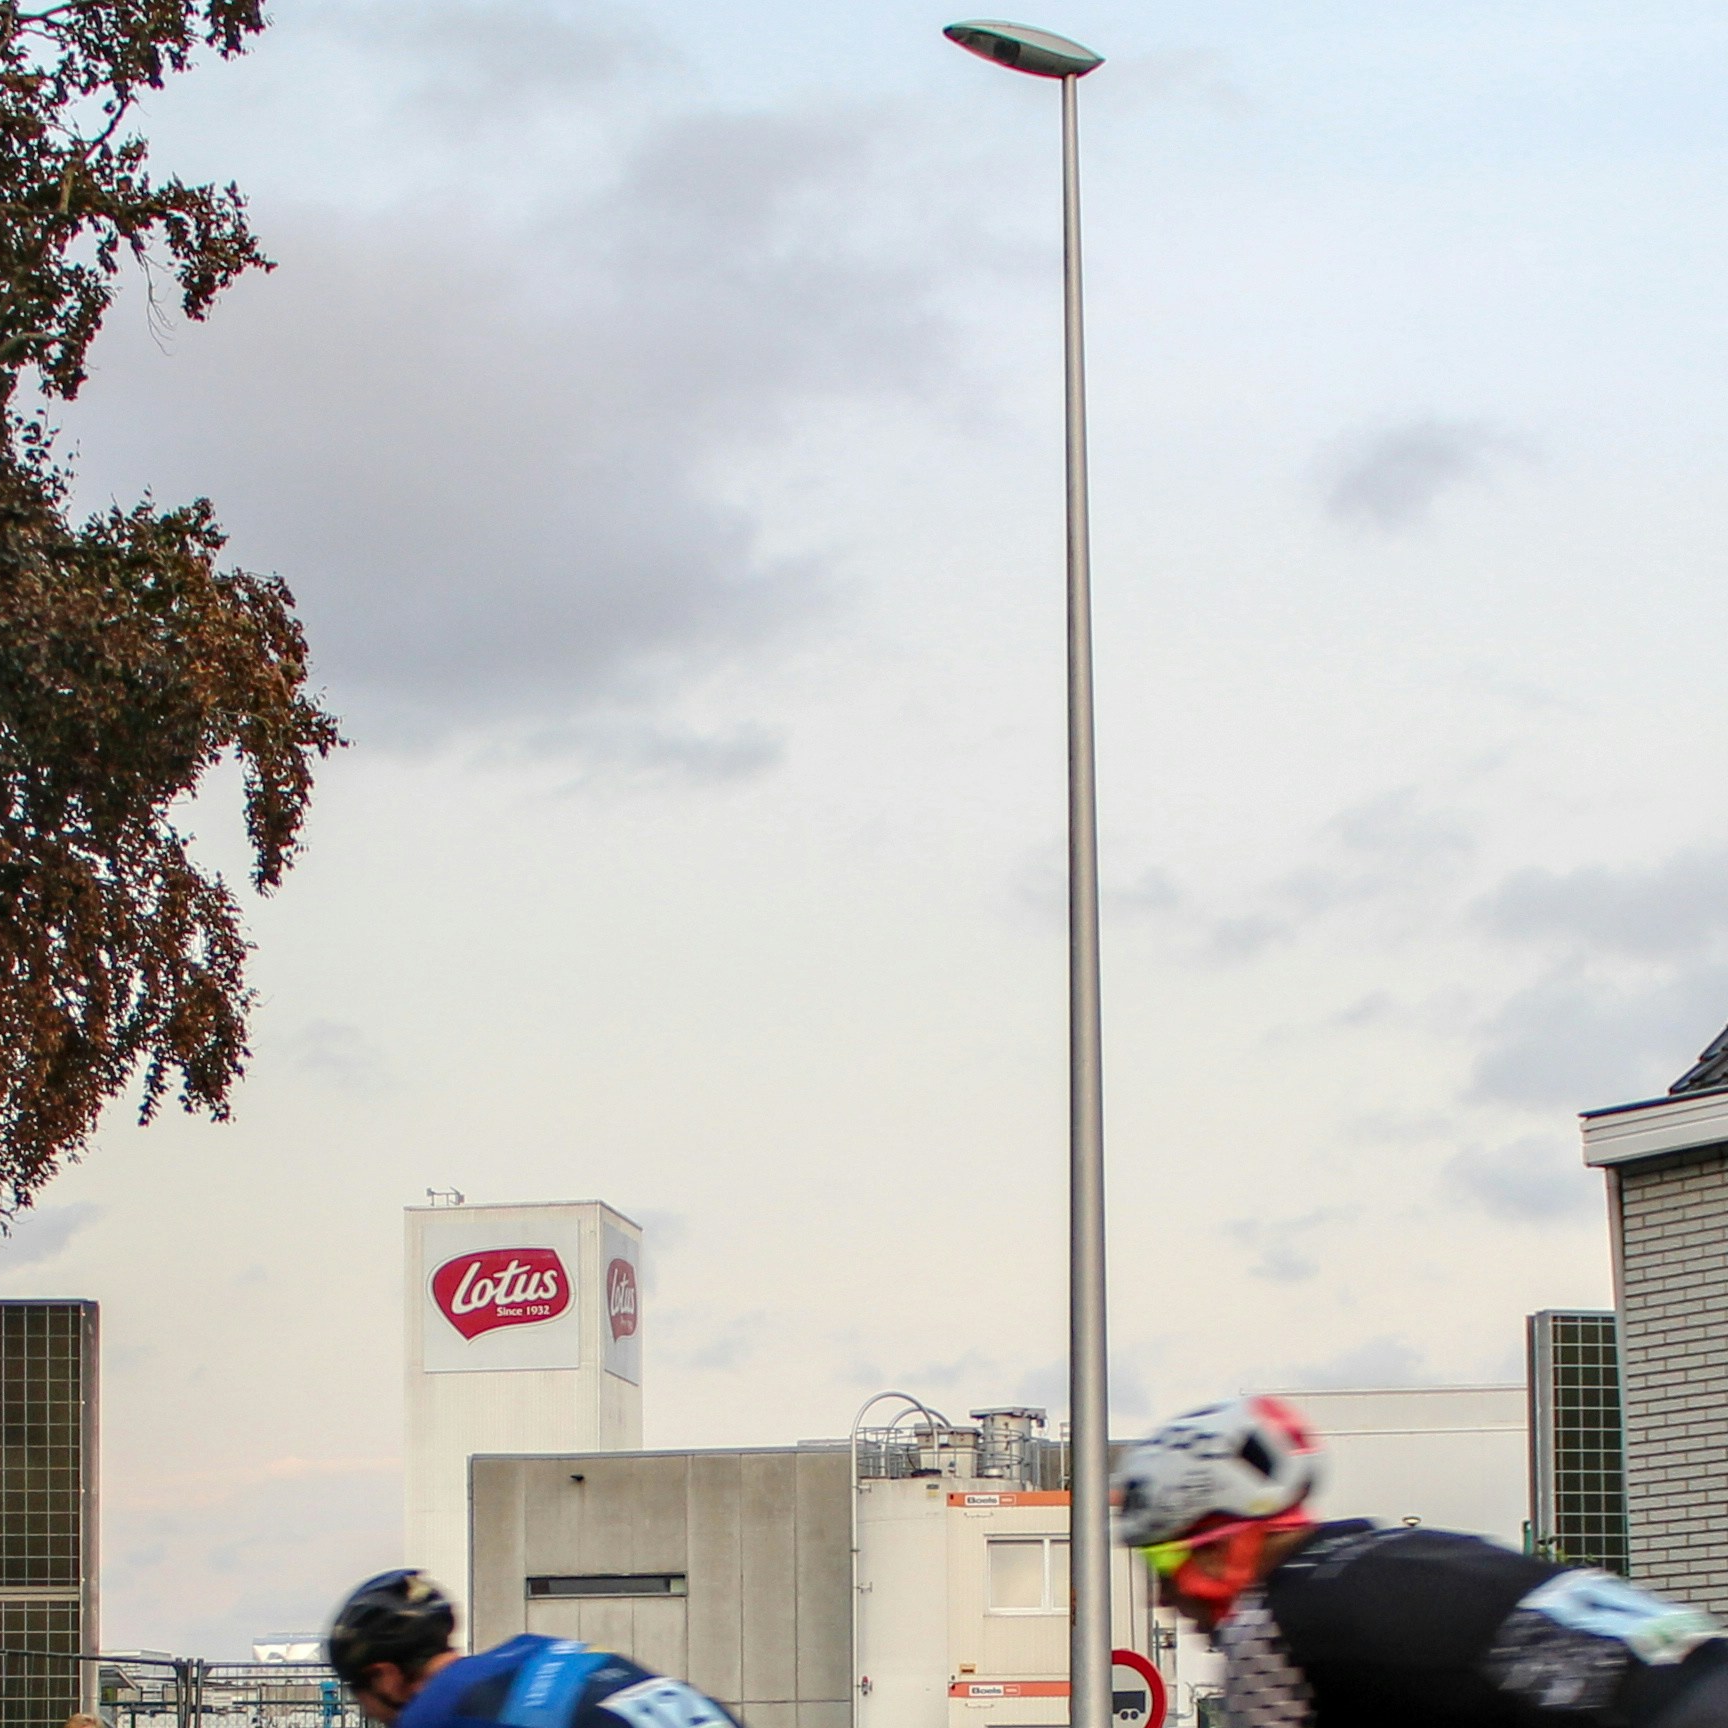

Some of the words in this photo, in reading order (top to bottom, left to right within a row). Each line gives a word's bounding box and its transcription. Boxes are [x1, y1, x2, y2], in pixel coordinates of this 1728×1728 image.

[451, 1259, 559, 1315] Lotus
[610, 1267, 635, 1316] Lotus
[496, 1306, 524, 1317] Since
[526, 1304, 551, 1316] 1932
[971, 1686, 1002, 1695] Boels
